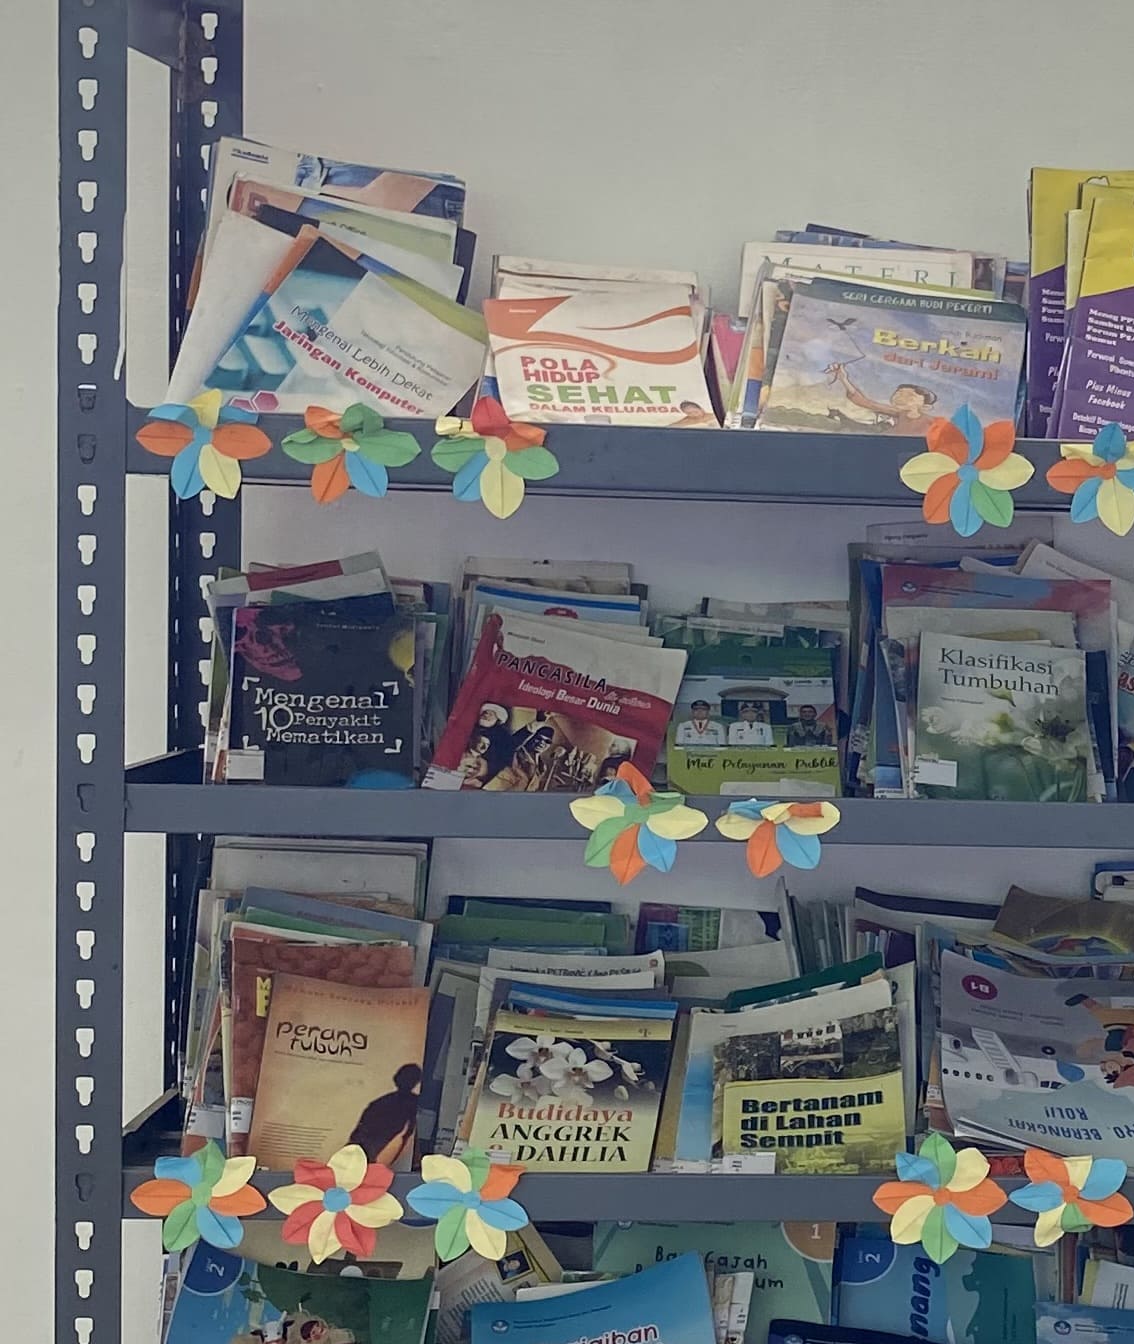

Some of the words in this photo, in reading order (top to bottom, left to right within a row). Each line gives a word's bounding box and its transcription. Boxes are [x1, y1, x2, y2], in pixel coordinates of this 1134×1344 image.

[291, 305, 352, 353] Mengenal
[352, 349, 391, 378] Lebih
[873, 328, 1002, 363] Berkah
[273, 320, 341, 370] Jaringan
[345, 367, 425, 416] Komputer
[520, 356, 599, 371] POLA
[523, 369, 601, 384] HIDUP
[527, 384, 677, 404] SEHAT
[1087, 394, 1126, 410] Facebook
[529, 403, 587, 413] DALAM
[591, 403, 681, 414] KELUARGA
[939, 647, 1054, 675] Klasifikasi
[496, 653, 609, 694] PANCASILA
[938, 668, 1060, 697] Tumbuhan
[254, 687, 390, 713] Mengenal
[587, 696, 621, 716] Dunia
[254, 706, 294, 732] 10
[294, 712, 381, 729] Penyakit
[266, 727, 385, 745] Mematikan
[275, 1021, 368, 1050] perang
[289, 1035, 353, 1057] tubuh
[741, 1089, 884, 1114] Bertanam
[498, 1103, 634, 1126] Budidaya
[740, 1115, 769, 1131] di
[776, 1110, 862, 1131] Lahan
[489, 1123, 631, 1142] ANGGREK
[740, 1130, 846, 1149] Sempit
[1007, 1117, 1102, 1141] BERANGKAT
[515, 1145, 628, 1162] DAHLIA
